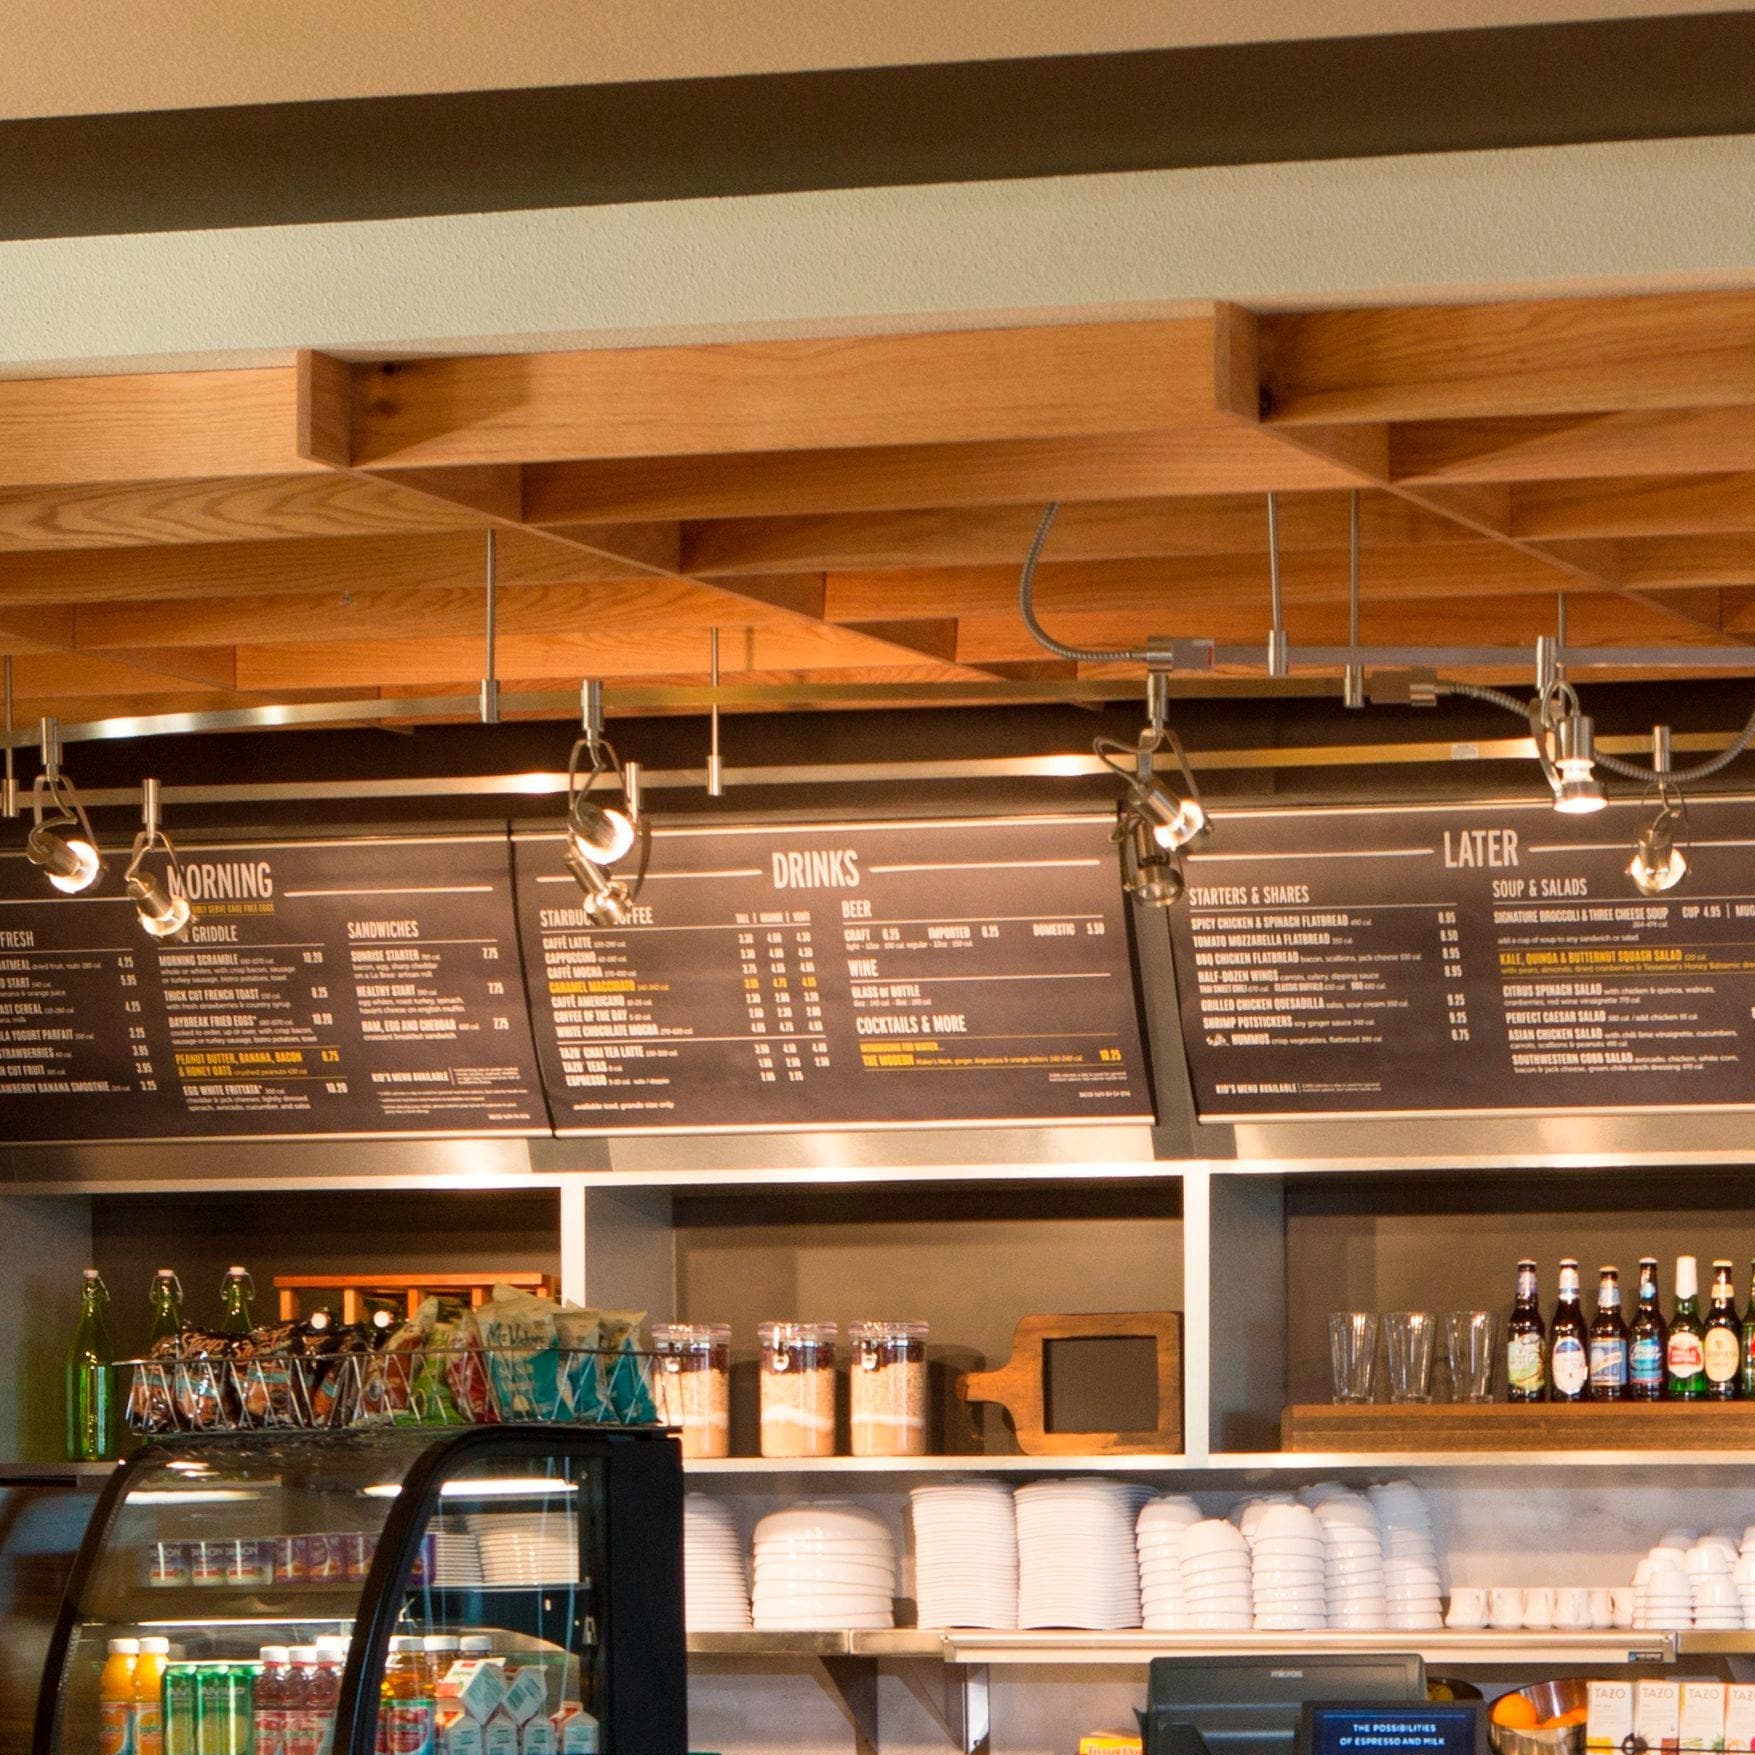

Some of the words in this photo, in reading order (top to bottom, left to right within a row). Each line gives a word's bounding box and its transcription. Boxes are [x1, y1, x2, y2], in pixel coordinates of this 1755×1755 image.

[1444, 829, 1518, 869] LATER
[772, 850, 860, 888] DRINKS
[167, 862, 273, 899] MORNING
[1492, 880, 1524, 898] SOUP
[1529, 879, 1537, 896] &
[1541, 878, 1588, 896] SALADS
[1189, 887, 1247, 906] STARTERS
[1252, 887, 1259, 904] &
[1263, 885, 1309, 904] SHARES
[842, 900, 871, 918] BEER
[1494, 911, 1538, 923] SIGNATURE
[1540, 909, 1580, 923] BROCCOLI
[1582, 910, 1588, 921] &
[1588, 908, 1614, 921] THREE
[1615, 908, 1644, 920] CHEESE
[1646, 907, 1668, 919] SOUP
[1682, 906, 1699, 918] CUP
[1704, 906, 1721, 918] 4.95
[1735, 905, 1755, 917] MUG
[348, 921, 419, 939] SANDWICHES
[1191, 917, 1215, 930] SPICY
[1218, 917, 1253, 930] CHICKEN
[1256, 917, 1261, 929] &
[1264, 916, 1300, 928] SPINACH
[1302, 915, 1348, 927] FLATBREAD
[0, 931, 34, 948] FRESH
[192, 925, 238, 942] GRIDDLE
[1193, 935, 1226, 948] TOMATO
[1228, 934, 1282, 947] MOZZARELLA
[1283, 933, 1330, 945] FLATBREAD
[848, 959, 878, 977] WINE
[852, 986, 878, 998] GLASS
[891, 985, 920, 997] BOTTLE
[1503, 985, 1533, 997] CITRUS
[1535, 984, 1572, 997] SPINACH
[1574, 983, 1602, 996] SALAD
[1201, 999, 1235, 1011] GRILLED
[1236, 998, 1273, 1010] CHICKEN
[1274, 998, 1324, 1010] QUESADILLA
[856, 1016, 918, 1034] COCKTAILS
[921, 1015, 930, 1033] &
[934, 1015, 967, 1032] MORE
[1508, 1029, 1534, 1041] ASIAN
[1536, 1028, 1573, 1040] CHICKEN
[1575, 1028, 1602, 1039] SALAD
[1512, 1053, 1579, 1065] SOUTHWESTERN
[1580, 1052, 1603, 1064] COBB
[1605, 1052, 1633, 1063] SALAD
[1594, 1688, 1626, 1700] TAZO
[1642, 1687, 1674, 1699] TAZO
[1688, 1688, 1720, 1700] TAZO
[1353, 1724, 1370, 1733] THE
[1373, 1723, 1436, 1733] POSSIBILITIES
[1339, 1737, 1353, 1746] OF
[1355, 1737, 1401, 1746] ESPRESSO
[1402, 1737, 1421, 1746] AND
[1423, 1737, 1445, 1746] MILK
